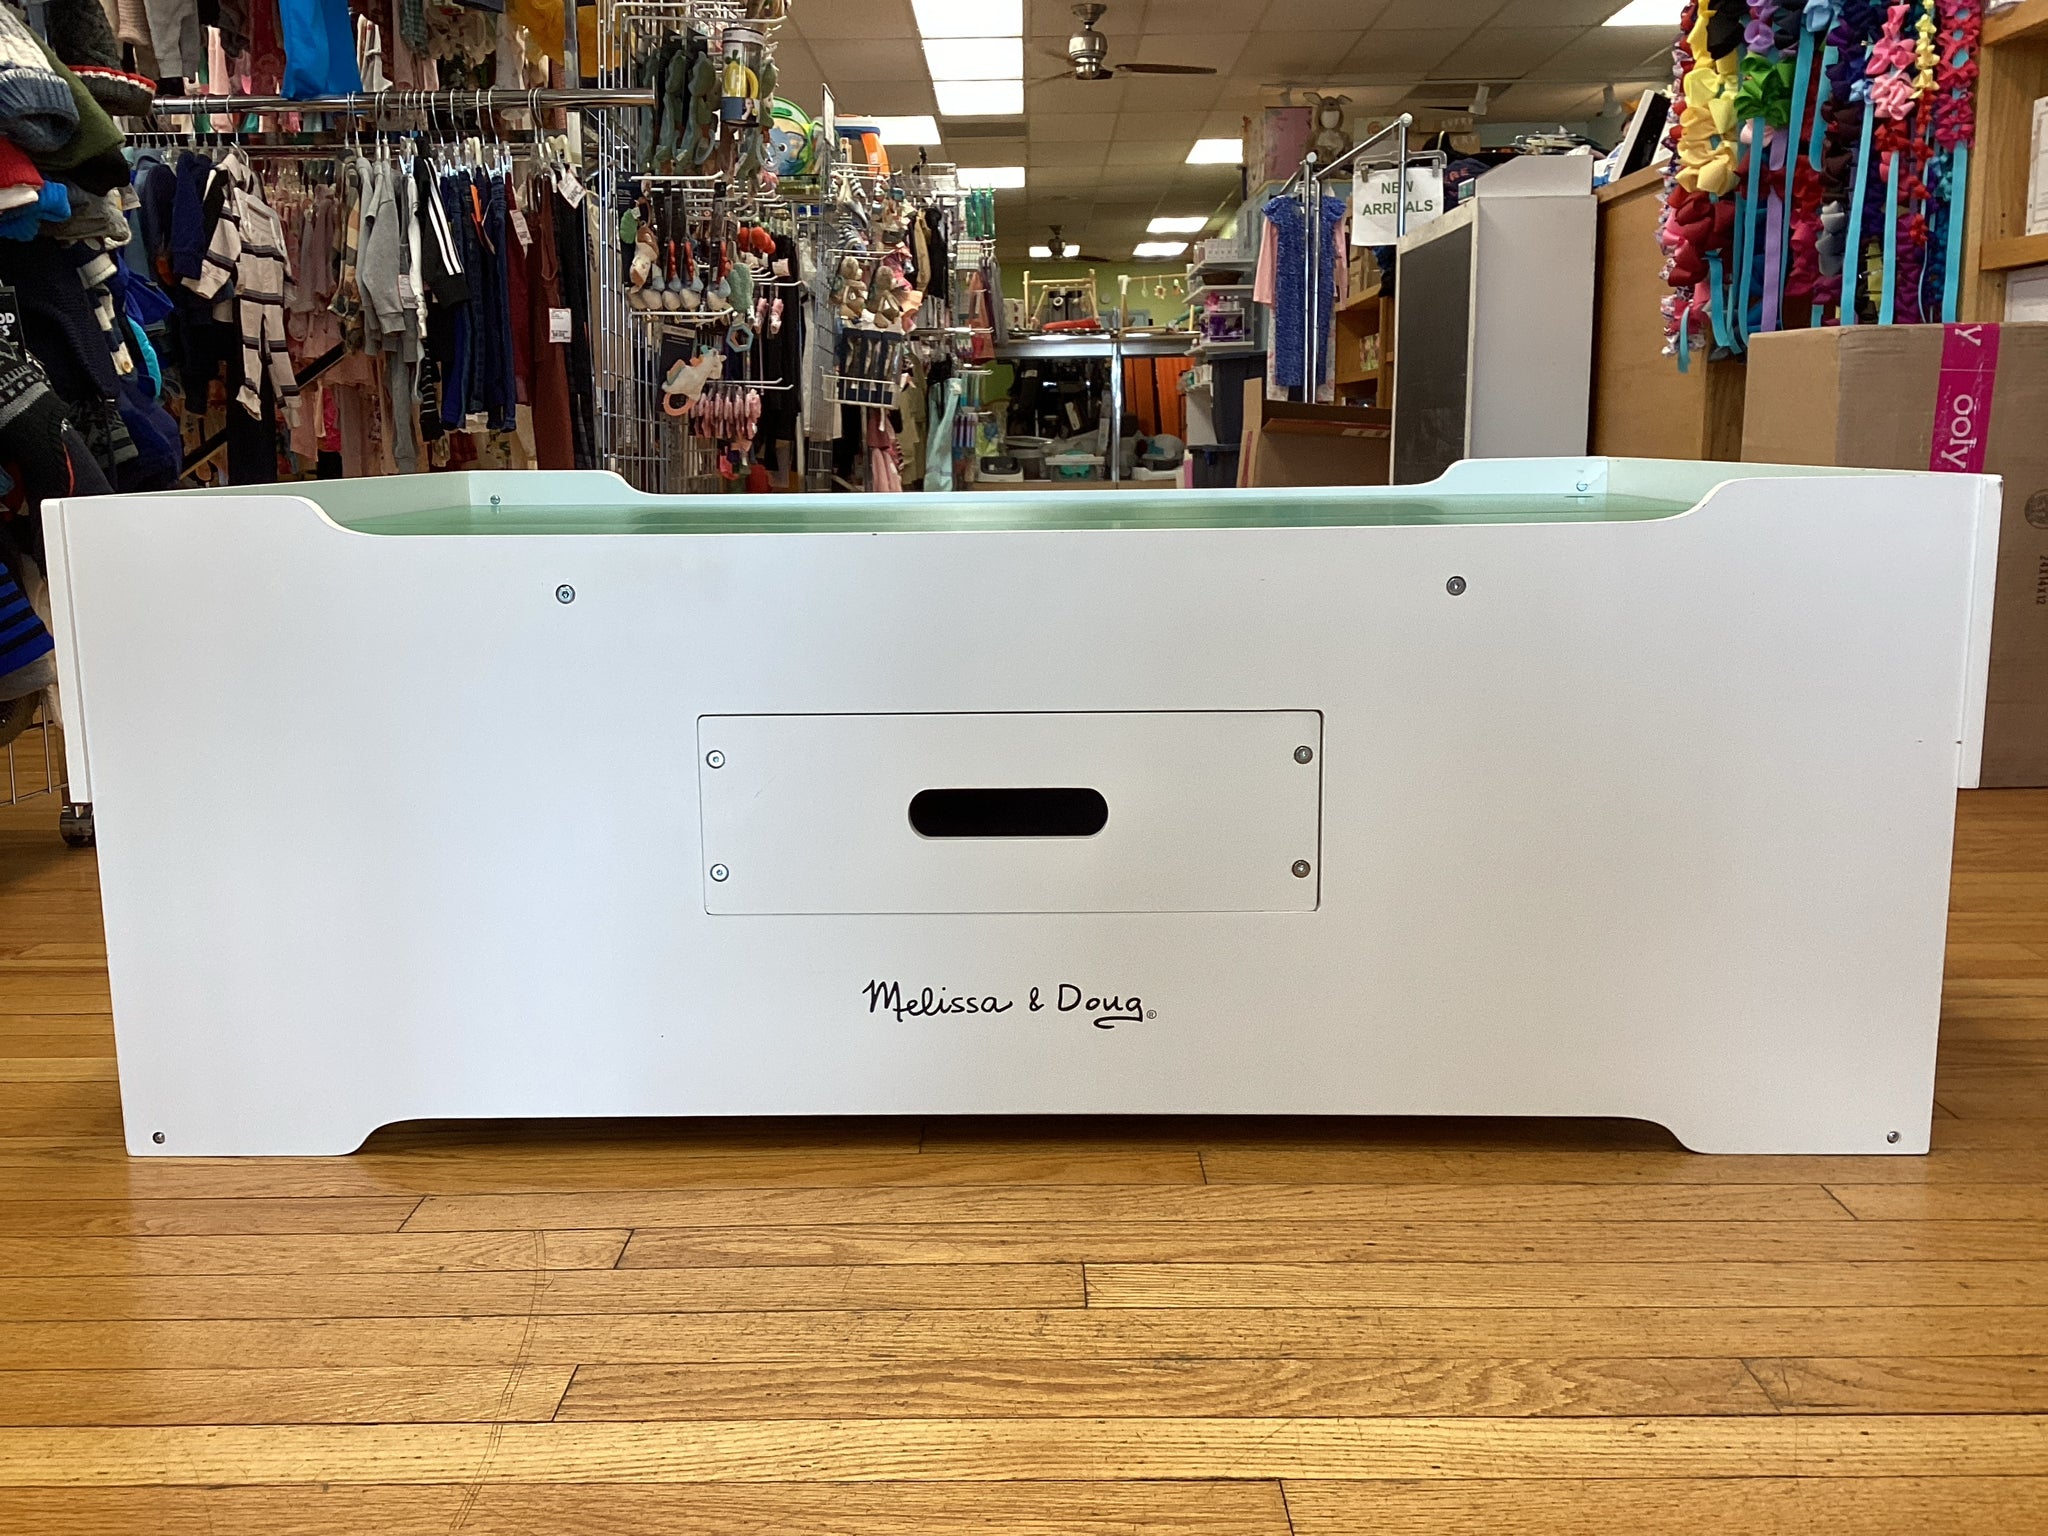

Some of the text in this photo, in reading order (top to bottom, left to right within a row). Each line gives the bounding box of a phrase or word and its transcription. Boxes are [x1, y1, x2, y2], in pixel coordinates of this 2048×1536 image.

[1362, 199, 1434, 216] ARRIALS
[861, 979, 1014, 1023] Melissa
[1028, 986, 1045, 1012] &
